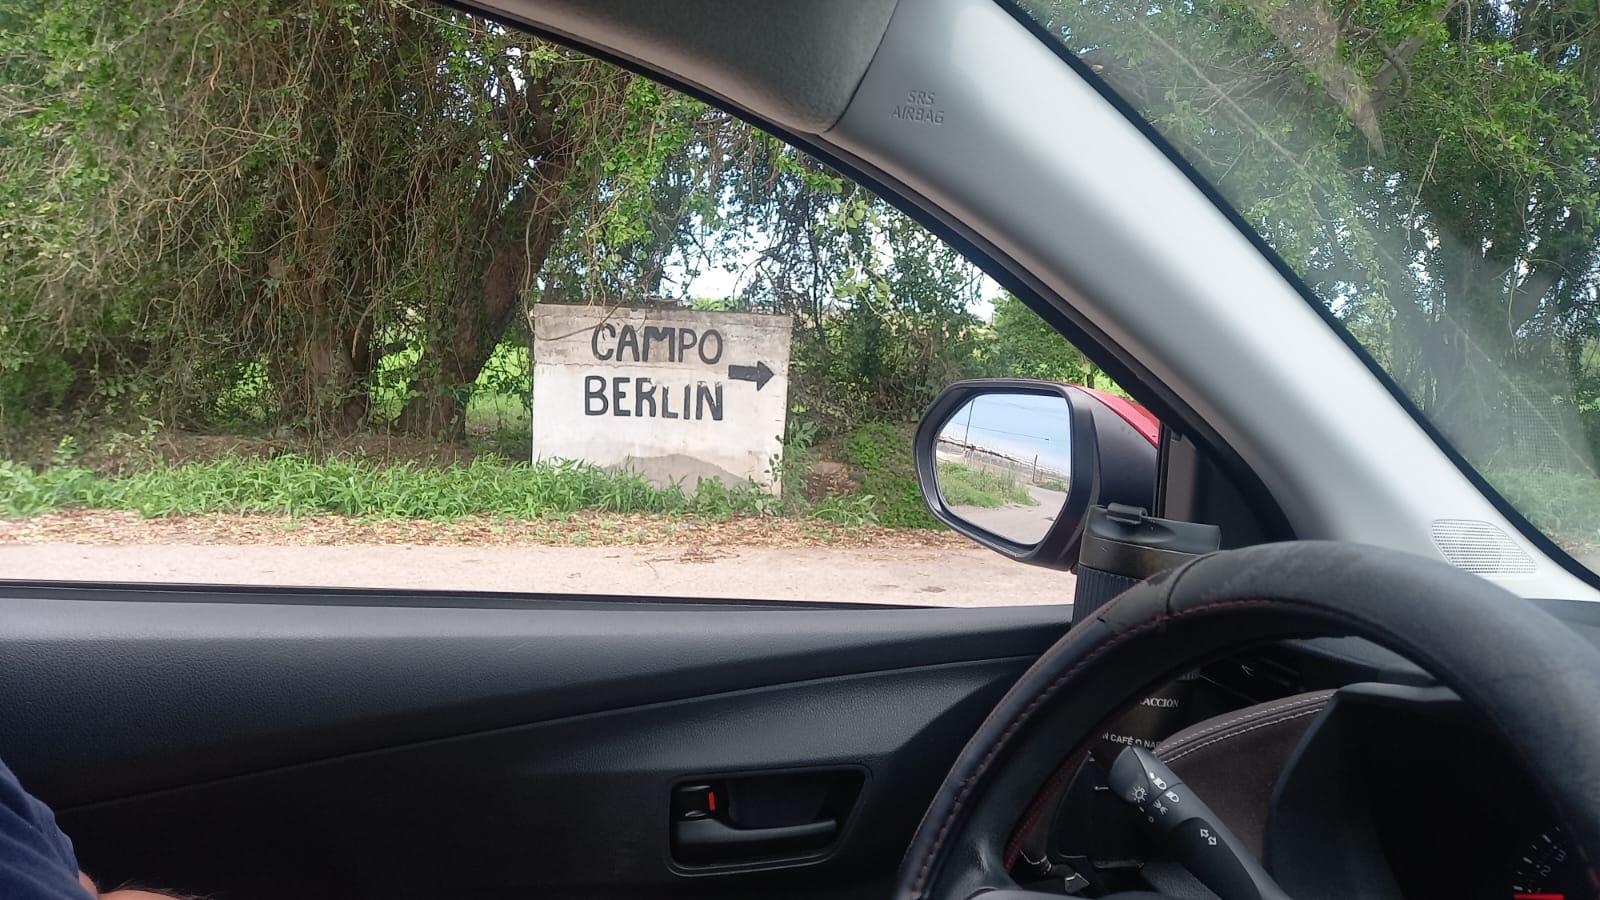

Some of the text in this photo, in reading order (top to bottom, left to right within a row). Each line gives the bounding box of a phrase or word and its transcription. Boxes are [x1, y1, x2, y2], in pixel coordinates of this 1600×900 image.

[907, 89, 935, 106] SRS
[891, 105, 945, 125] AIRBAG
[591, 323, 723, 365] CAMPO
[584, 375, 723, 421] BERLIN
